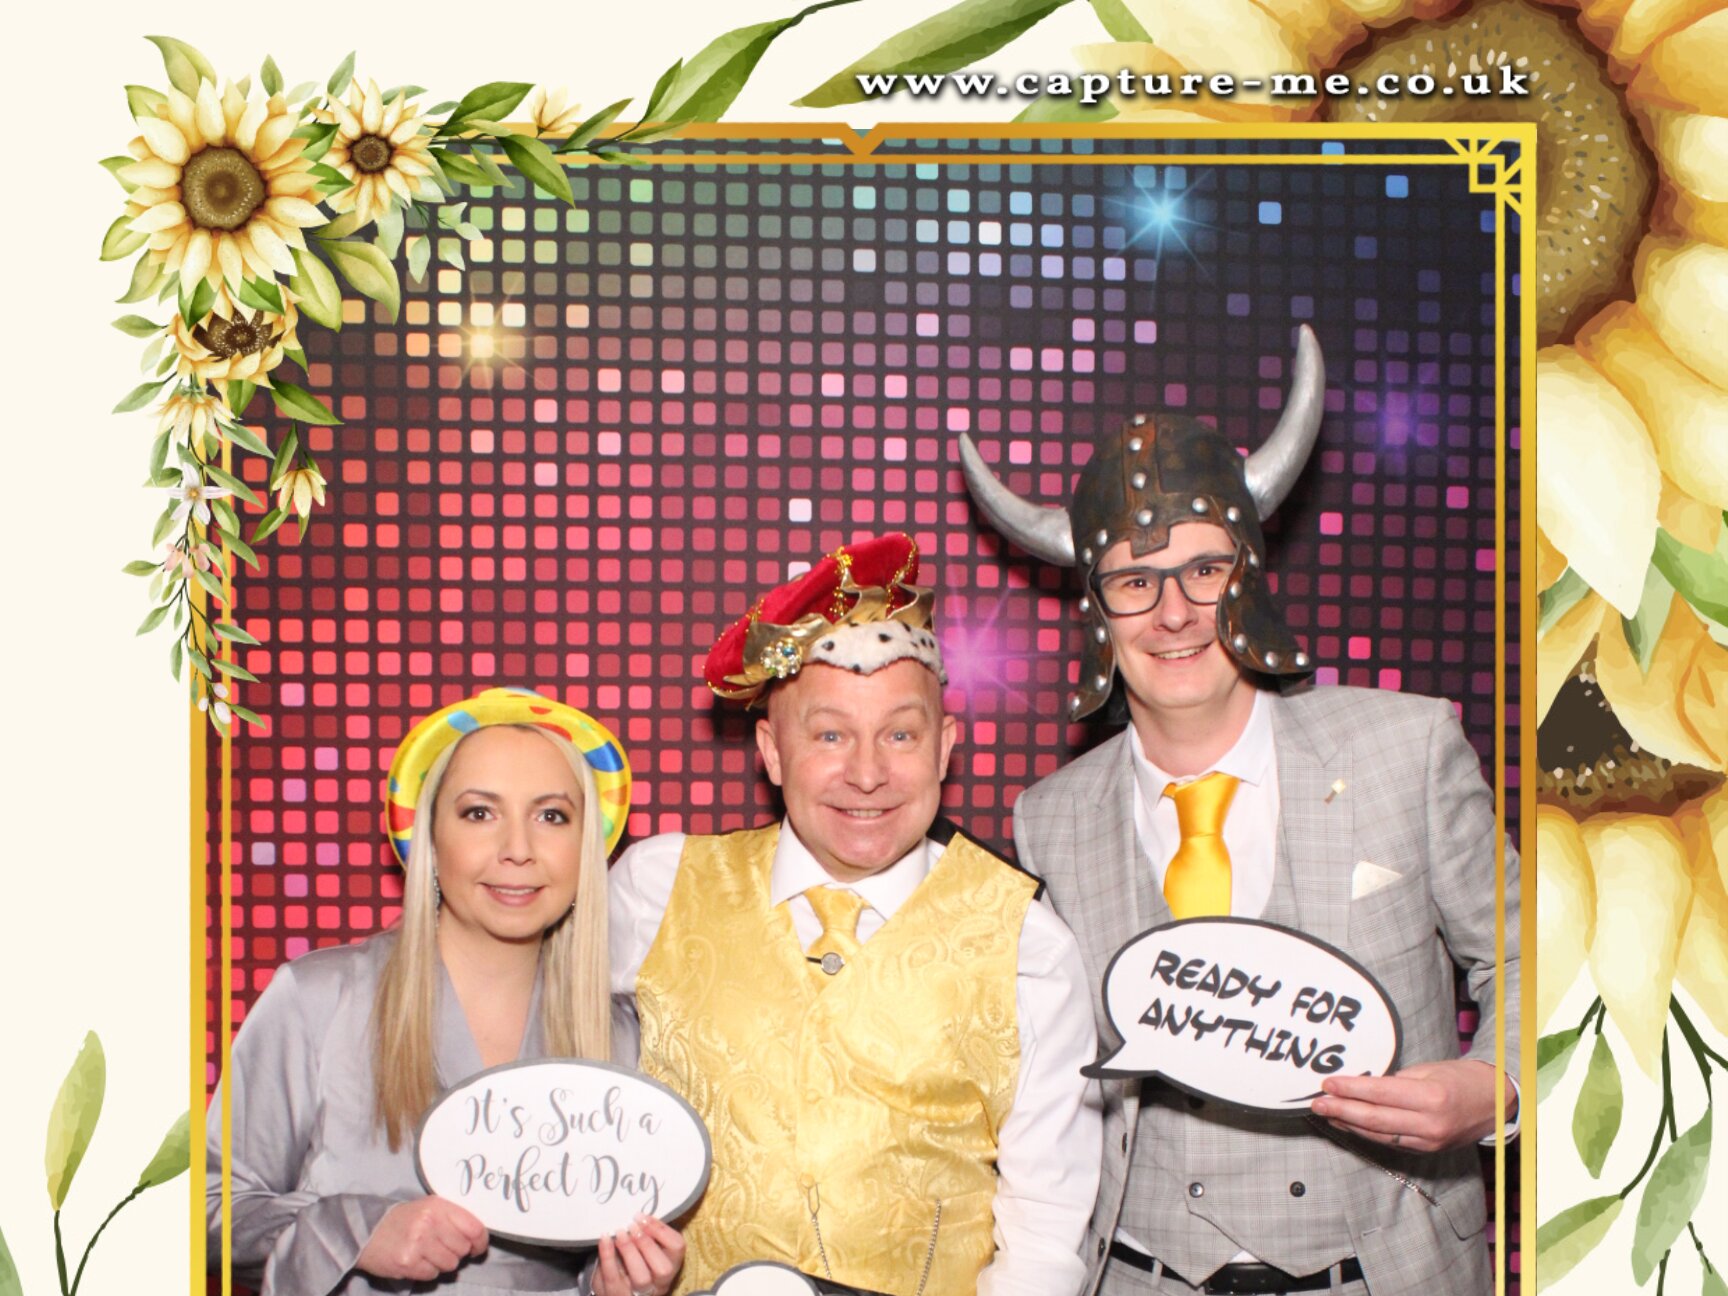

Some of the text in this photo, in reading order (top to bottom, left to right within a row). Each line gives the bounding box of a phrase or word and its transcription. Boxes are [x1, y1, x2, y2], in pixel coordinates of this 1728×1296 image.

[1150, 949, 1362, 1032] READY FOR
[1138, 997, 1346, 1075] ANYTHING
[464, 1086, 663, 1146] It's Such a
[456, 1145, 665, 1215] Perfect Day
